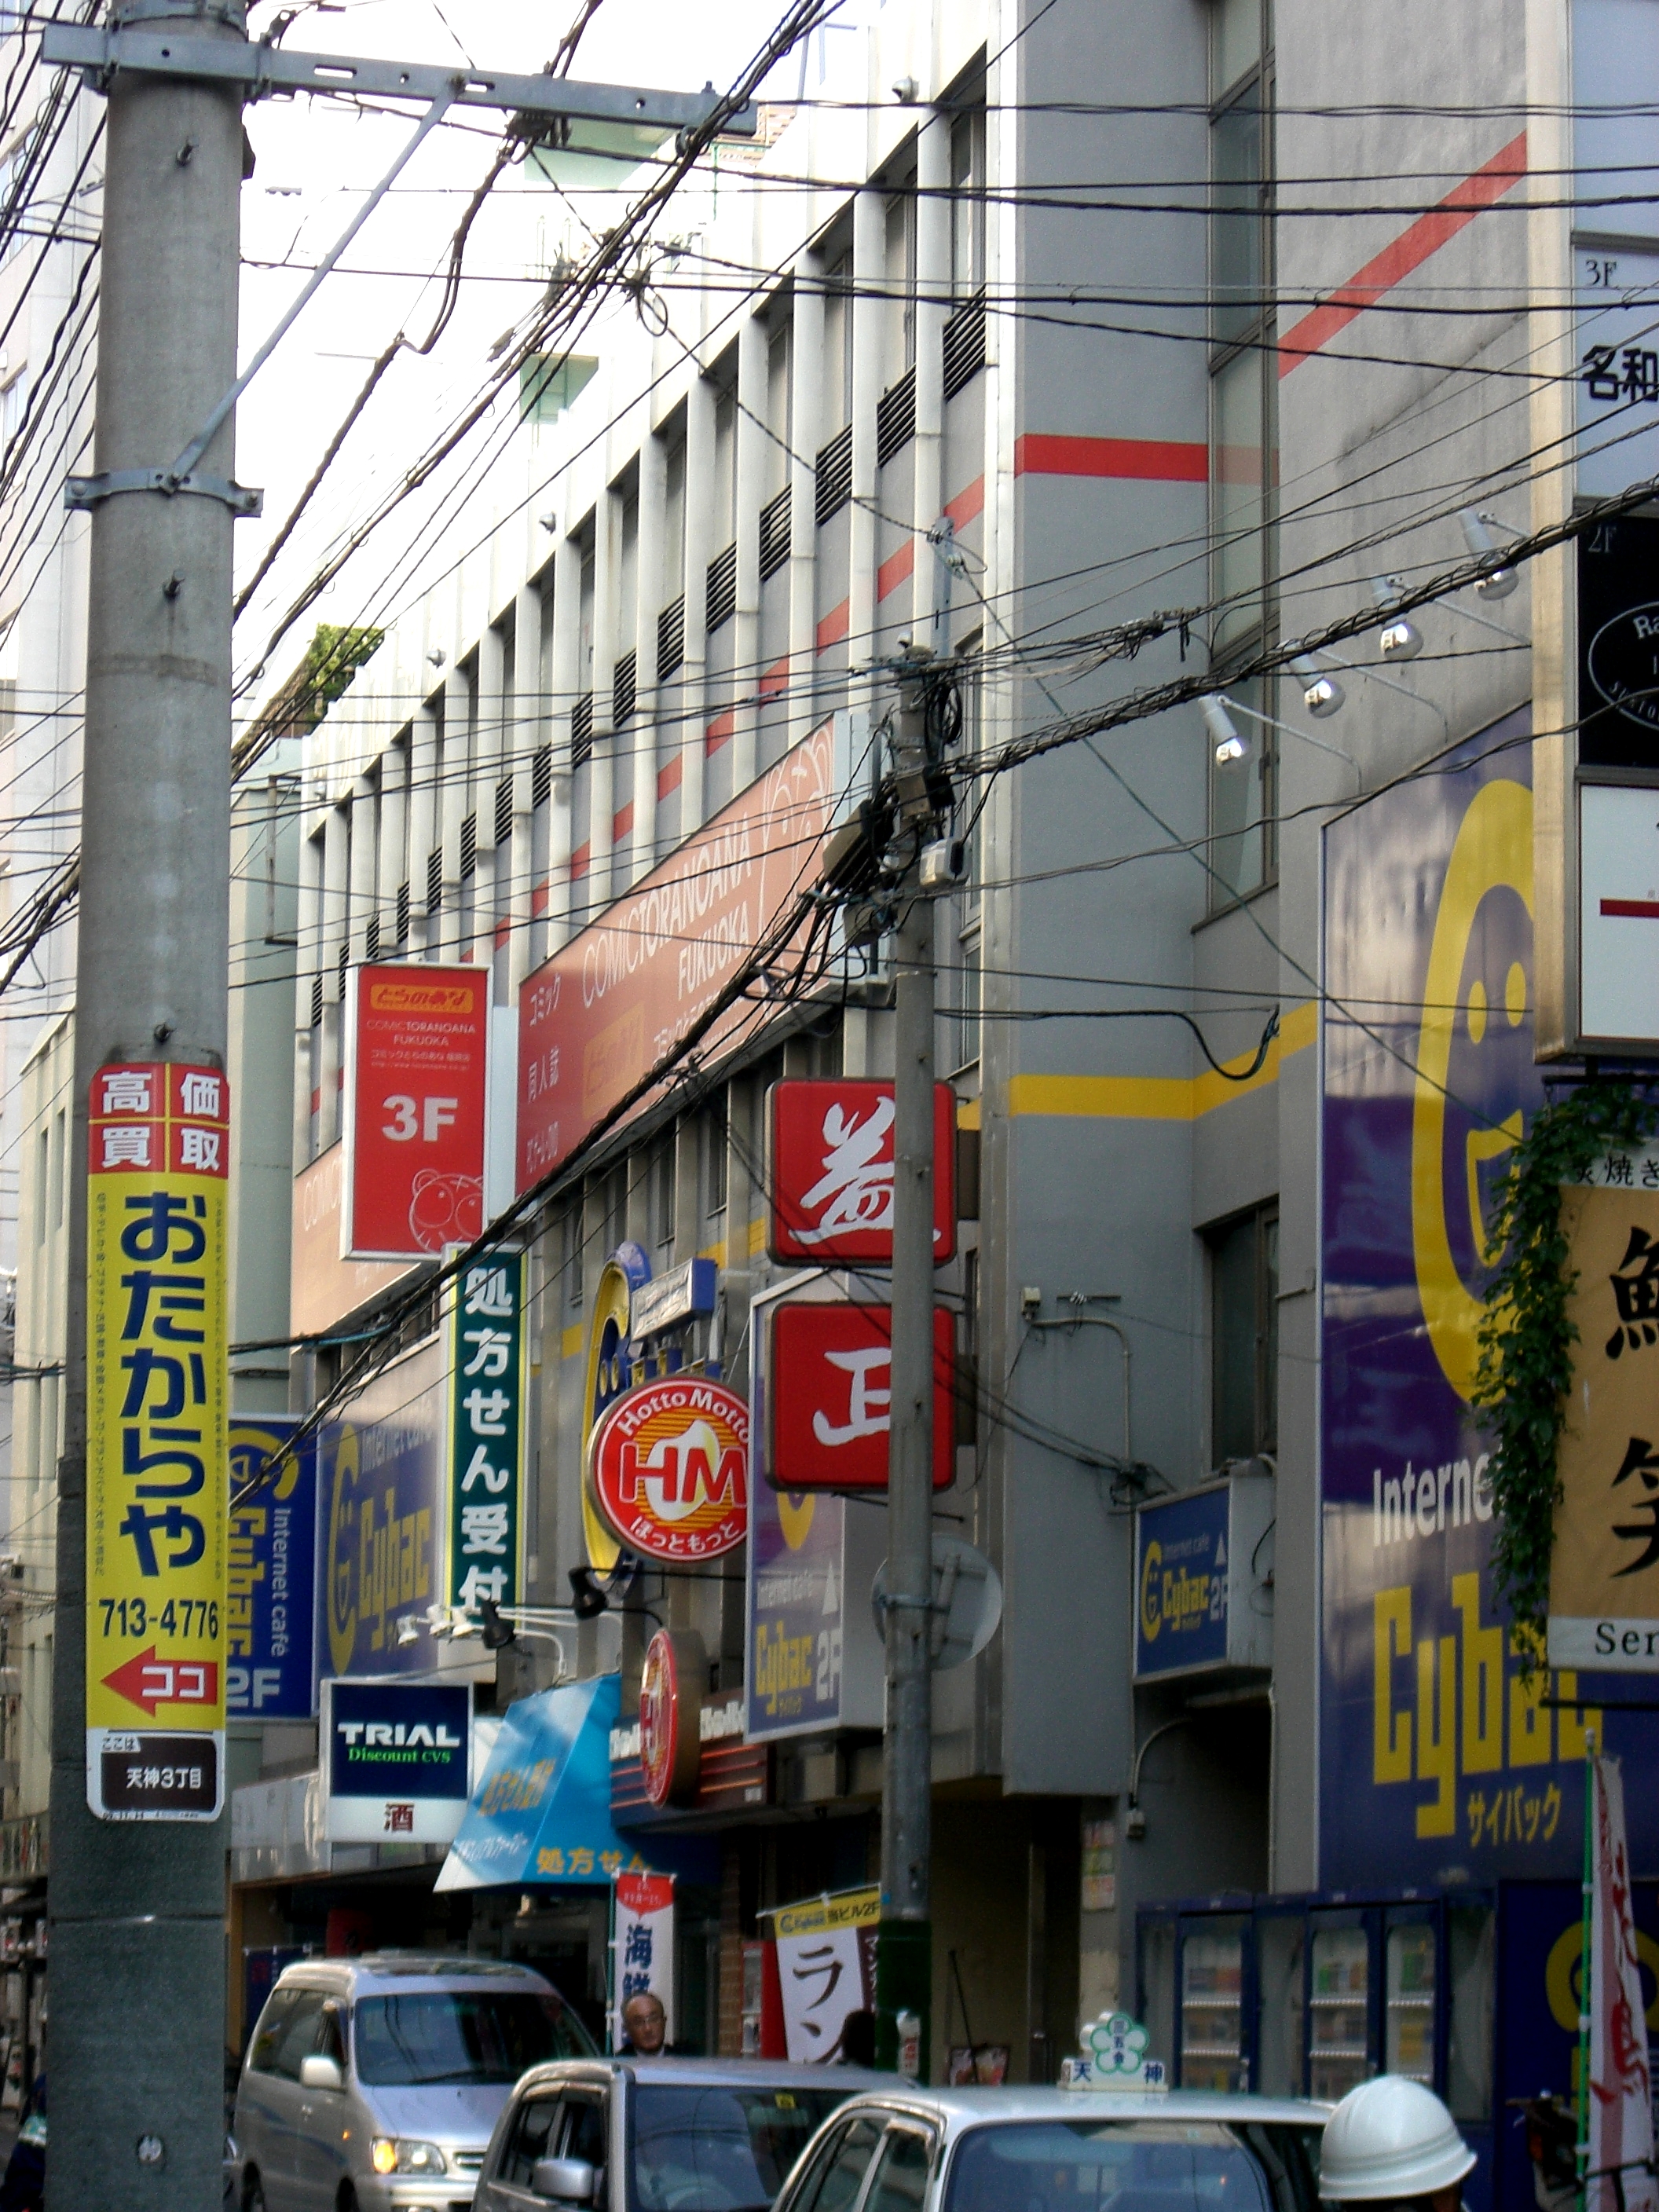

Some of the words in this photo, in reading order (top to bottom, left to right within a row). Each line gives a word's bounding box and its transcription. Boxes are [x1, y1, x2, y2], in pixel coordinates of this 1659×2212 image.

[1585, 258, 1617, 287] 3F
[678, 901, 749, 1002] FUKUOKA
[101, 1071, 220, 1118] 高価
[382, 1094, 458, 1143] 3F
[101, 1126, 220, 1171] 買取
[119, 1191, 207, 1577] おたからや
[616, 1391, 687, 1436] Hotto
[688, 1386, 749, 1444] Motto
[459, 1267, 513, 1612] 処方せん受付
[1373, 1452, 1503, 1547] Interne
[273, 1507, 291, 1601] Internet
[630, 1515, 740, 1554] ほっともっと
[99, 1599, 218, 1639] 713-4776
[141, 1665, 205, 1698] ココ
[102, 1736, 134, 1751] ここは
[338, 1723, 460, 1748] TRIAL
[347, 1745, 419, 1763] Discount
[384, 1803, 415, 1833] 酒
[1467, 1782, 1562, 1848] サイパック
[1073, 2061, 1092, 2082] 天
